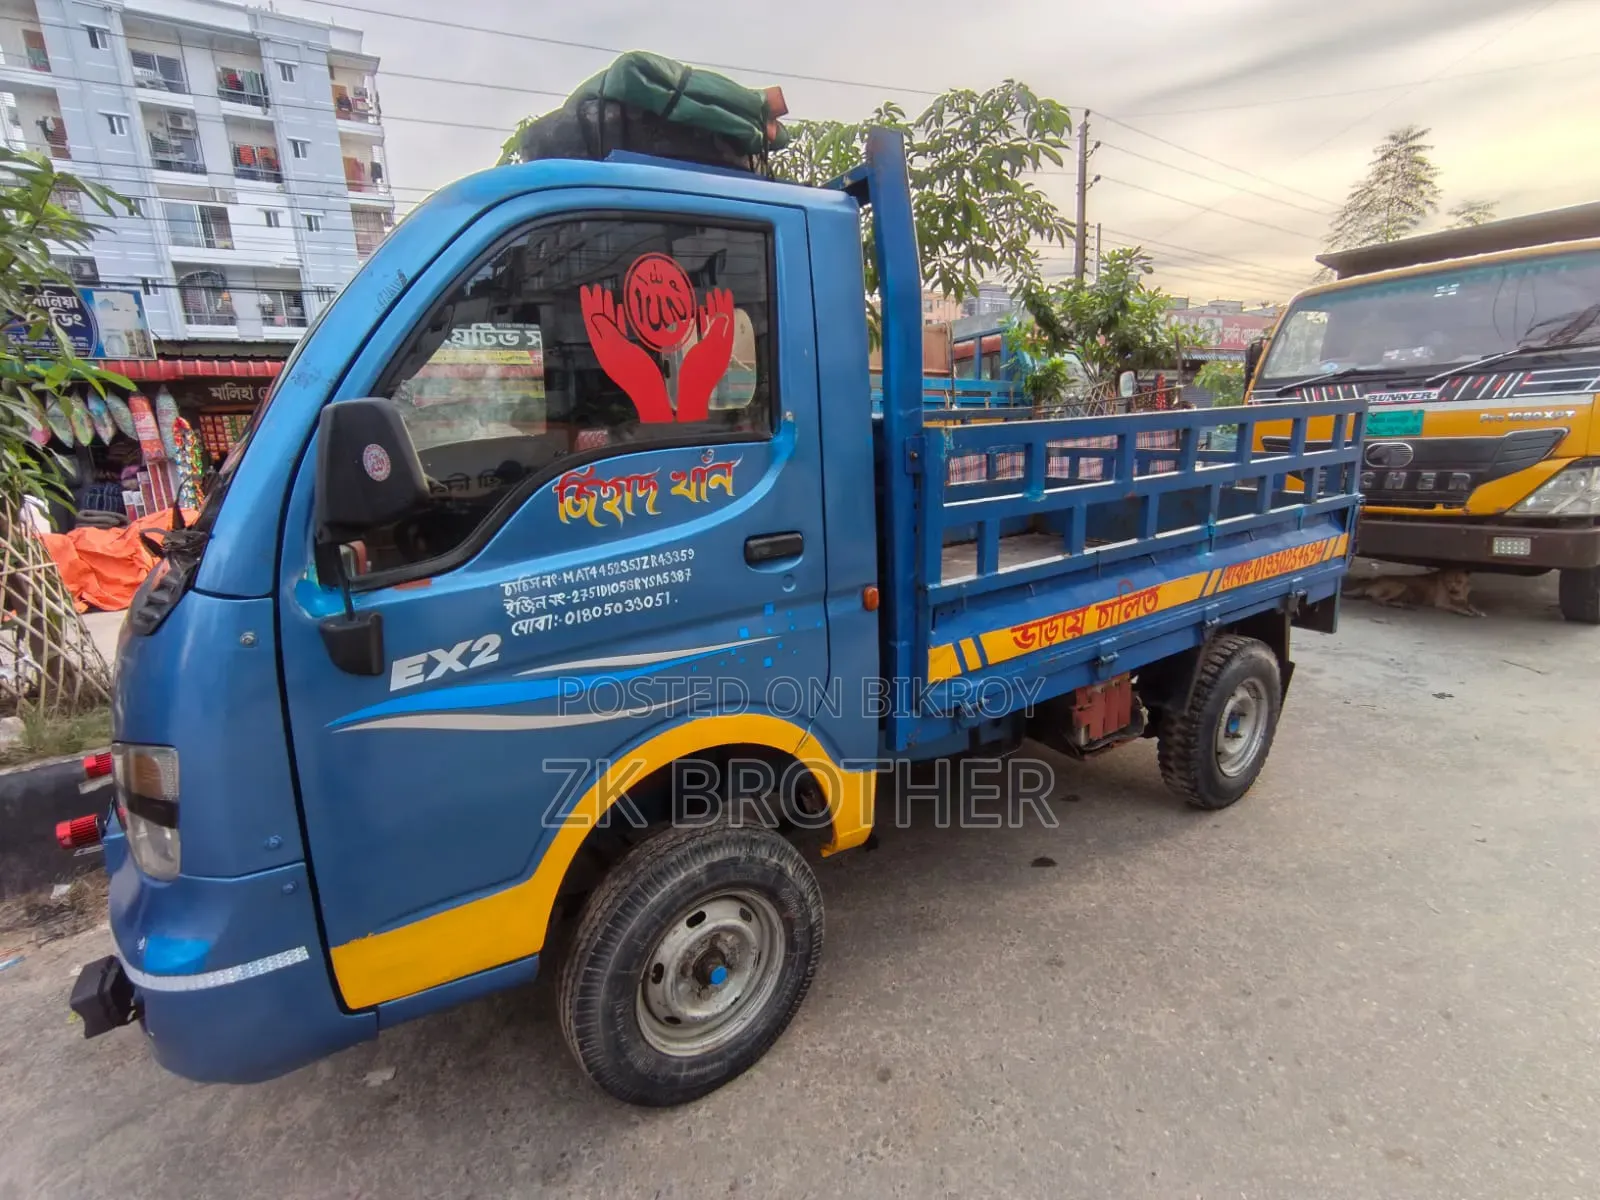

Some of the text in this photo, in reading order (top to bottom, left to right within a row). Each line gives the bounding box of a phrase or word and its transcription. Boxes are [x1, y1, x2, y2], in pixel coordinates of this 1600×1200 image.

[552, 466, 662, 529] জিহাদ
[1096, 579, 1161, 629] চালিত
[390, 634, 502, 692] EX2
